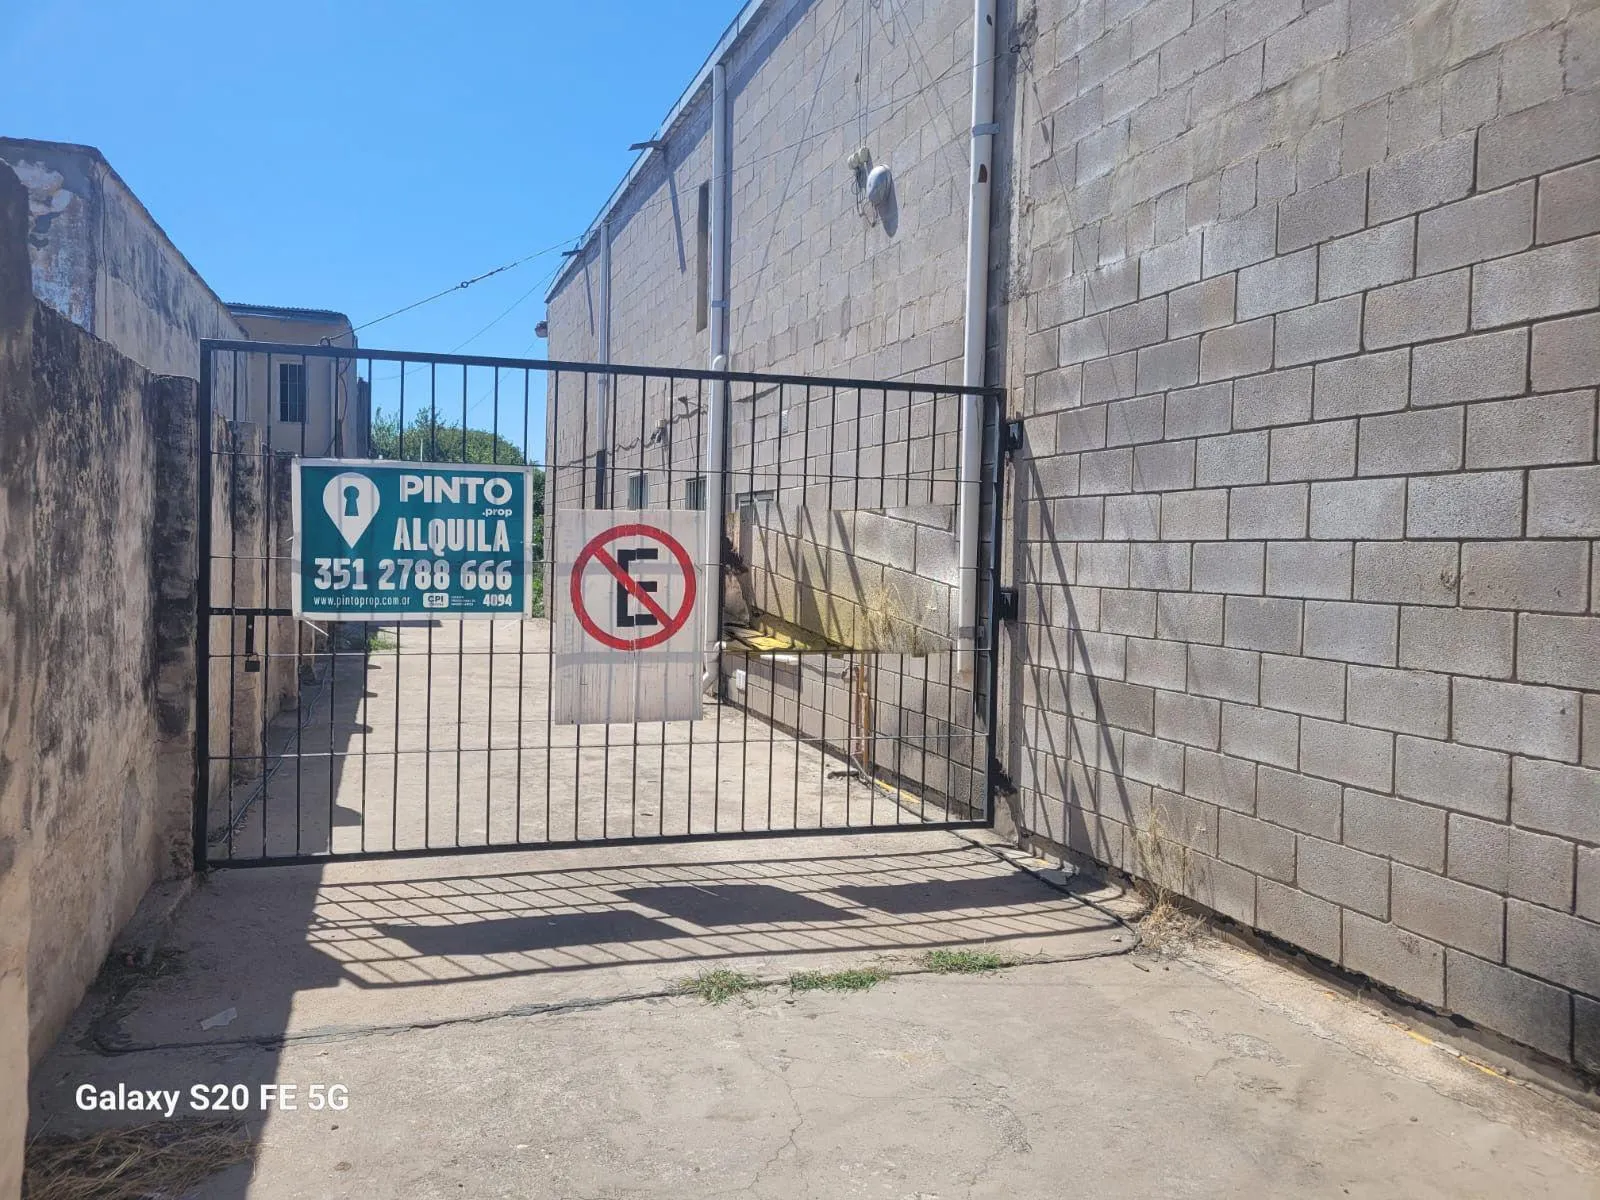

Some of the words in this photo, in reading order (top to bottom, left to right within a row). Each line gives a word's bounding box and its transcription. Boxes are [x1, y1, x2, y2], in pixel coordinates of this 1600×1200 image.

[400, 474, 513, 506] PINTO
[393, 517, 510, 556] ALQUILA
[314, 557, 368, 591] 351
[378, 558, 450, 591] 2788
[460, 559, 513, 591] 666
[617, 548, 659, 627] E
[313, 594, 410, 608] www.pintoprop.com.ar
